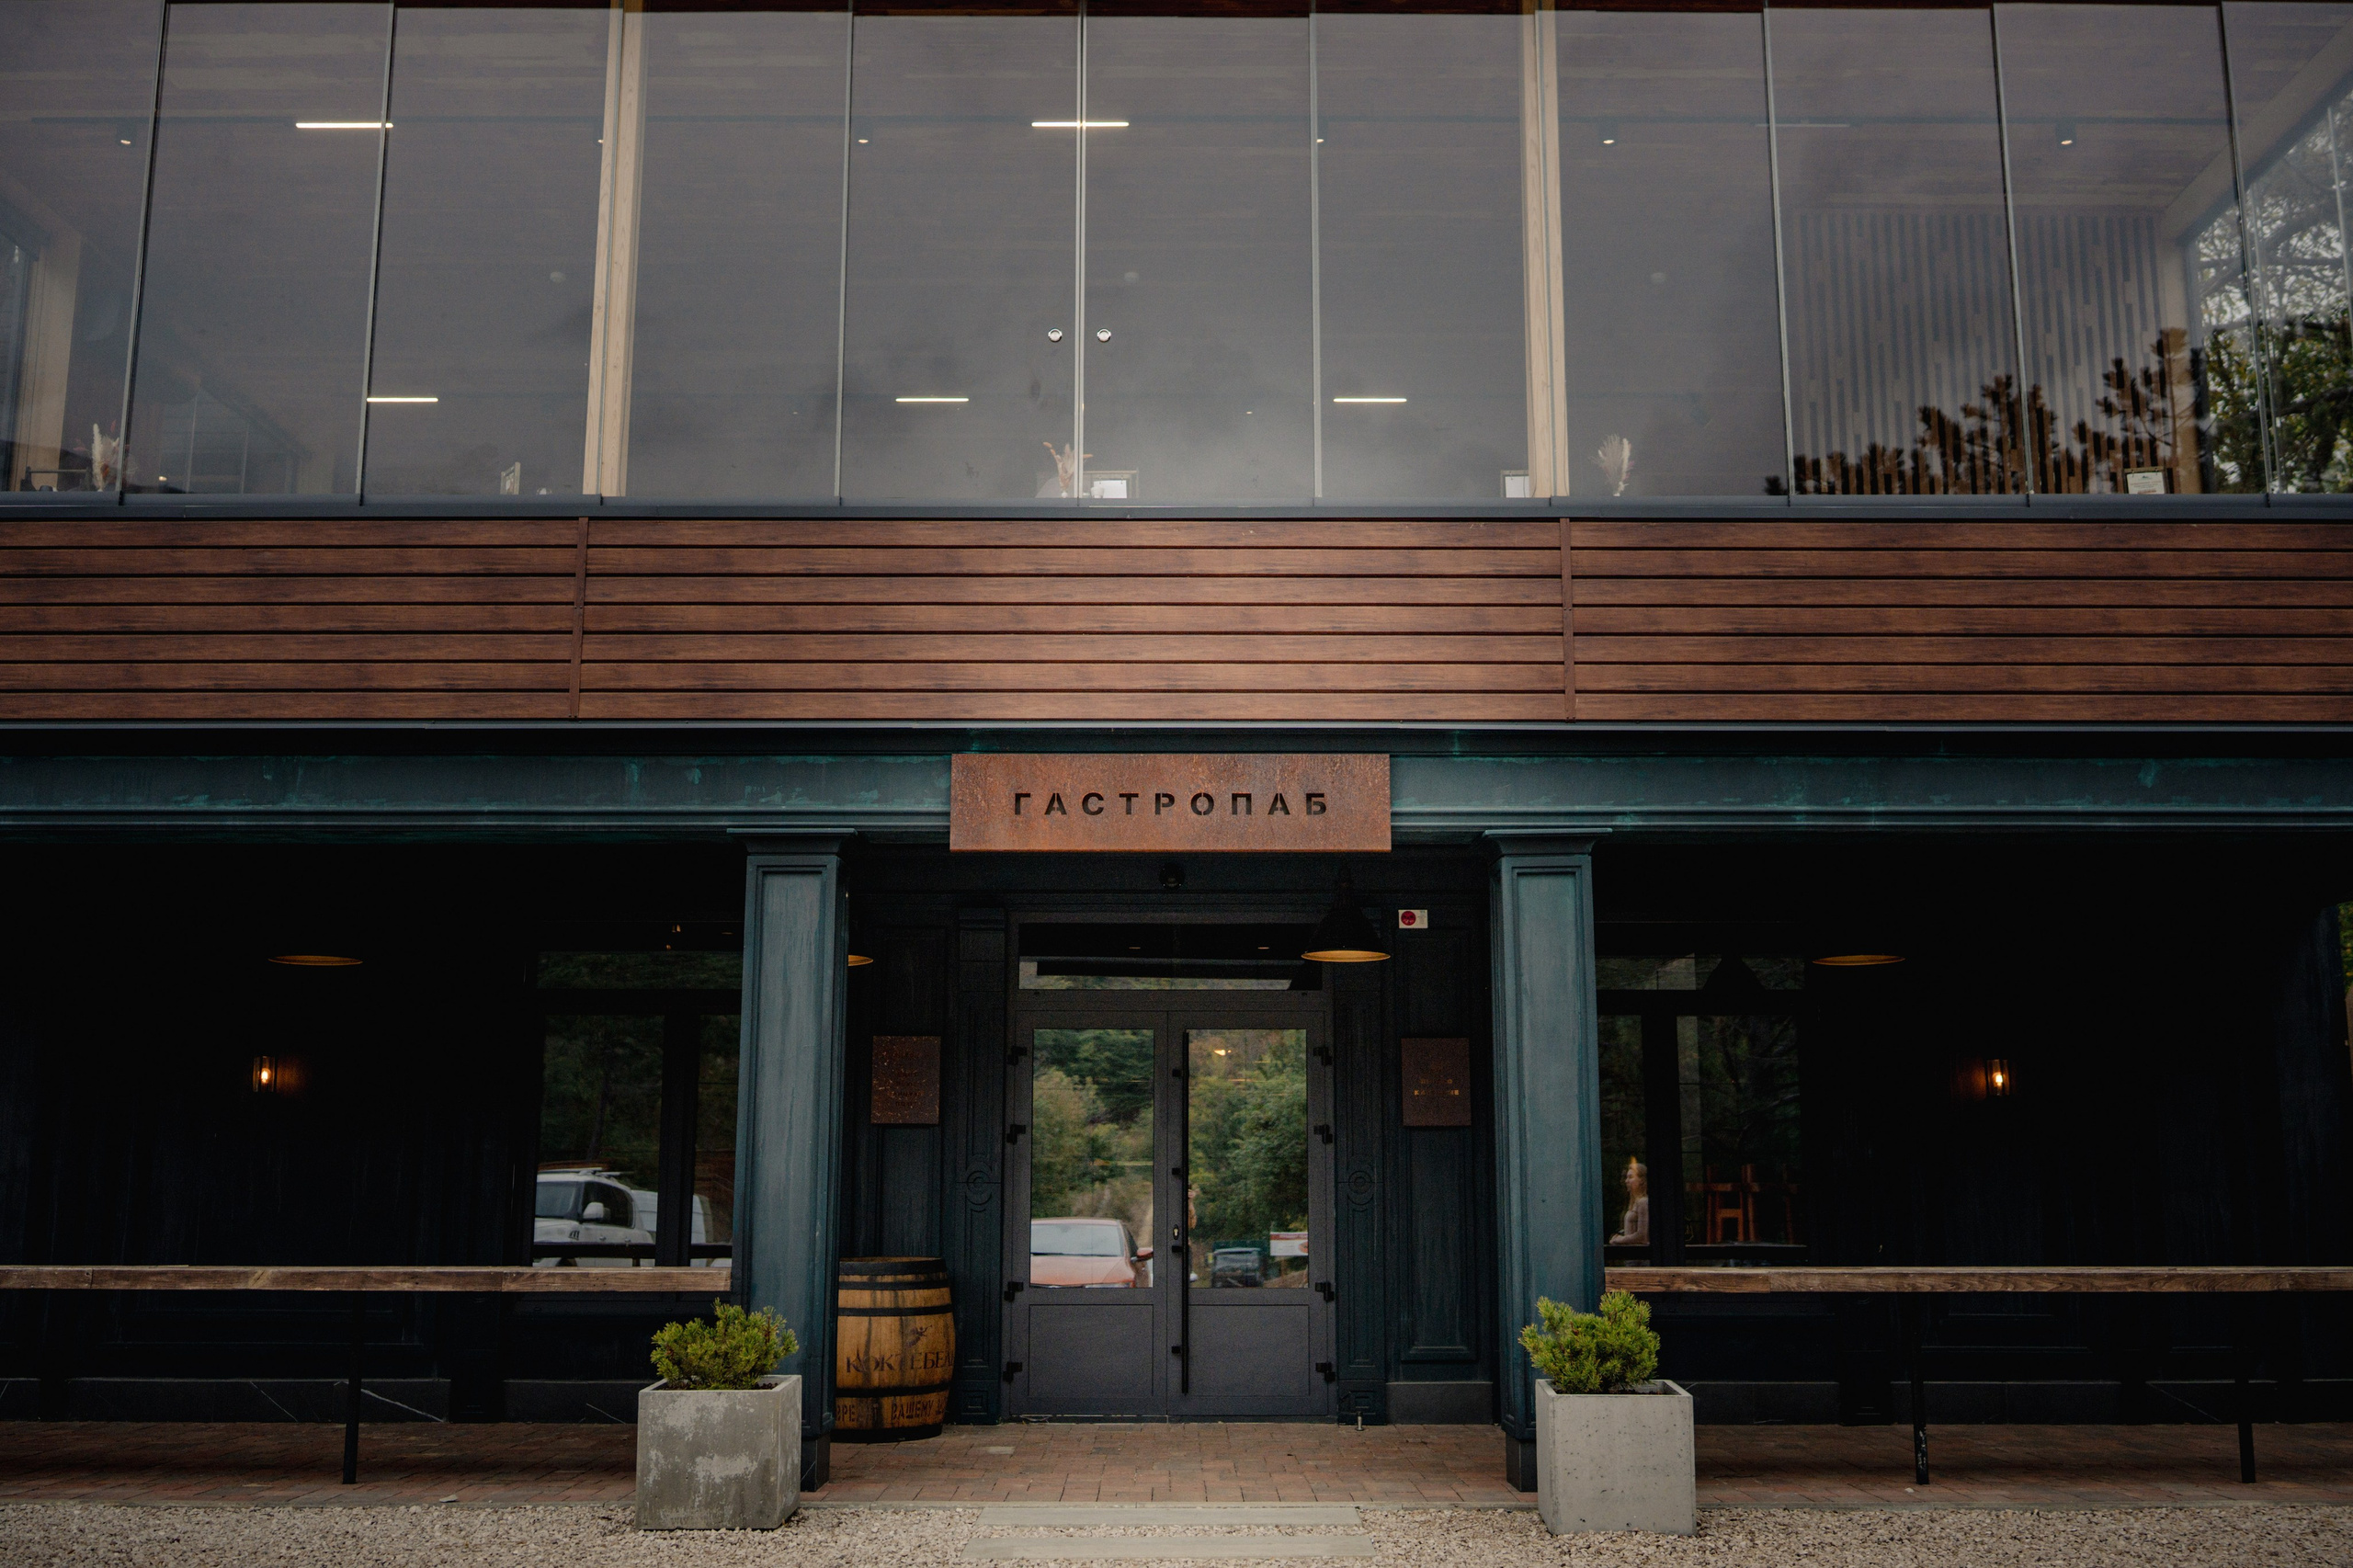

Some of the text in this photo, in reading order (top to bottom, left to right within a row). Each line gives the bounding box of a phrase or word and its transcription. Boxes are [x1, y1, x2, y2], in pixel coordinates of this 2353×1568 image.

[1014, 792, 1327, 816] ГАСТРОПАБ
[846, 1346, 954, 1373] КОКТЕБЕЛ
[890, 1399, 934, 1421] ВАШЕМУ
